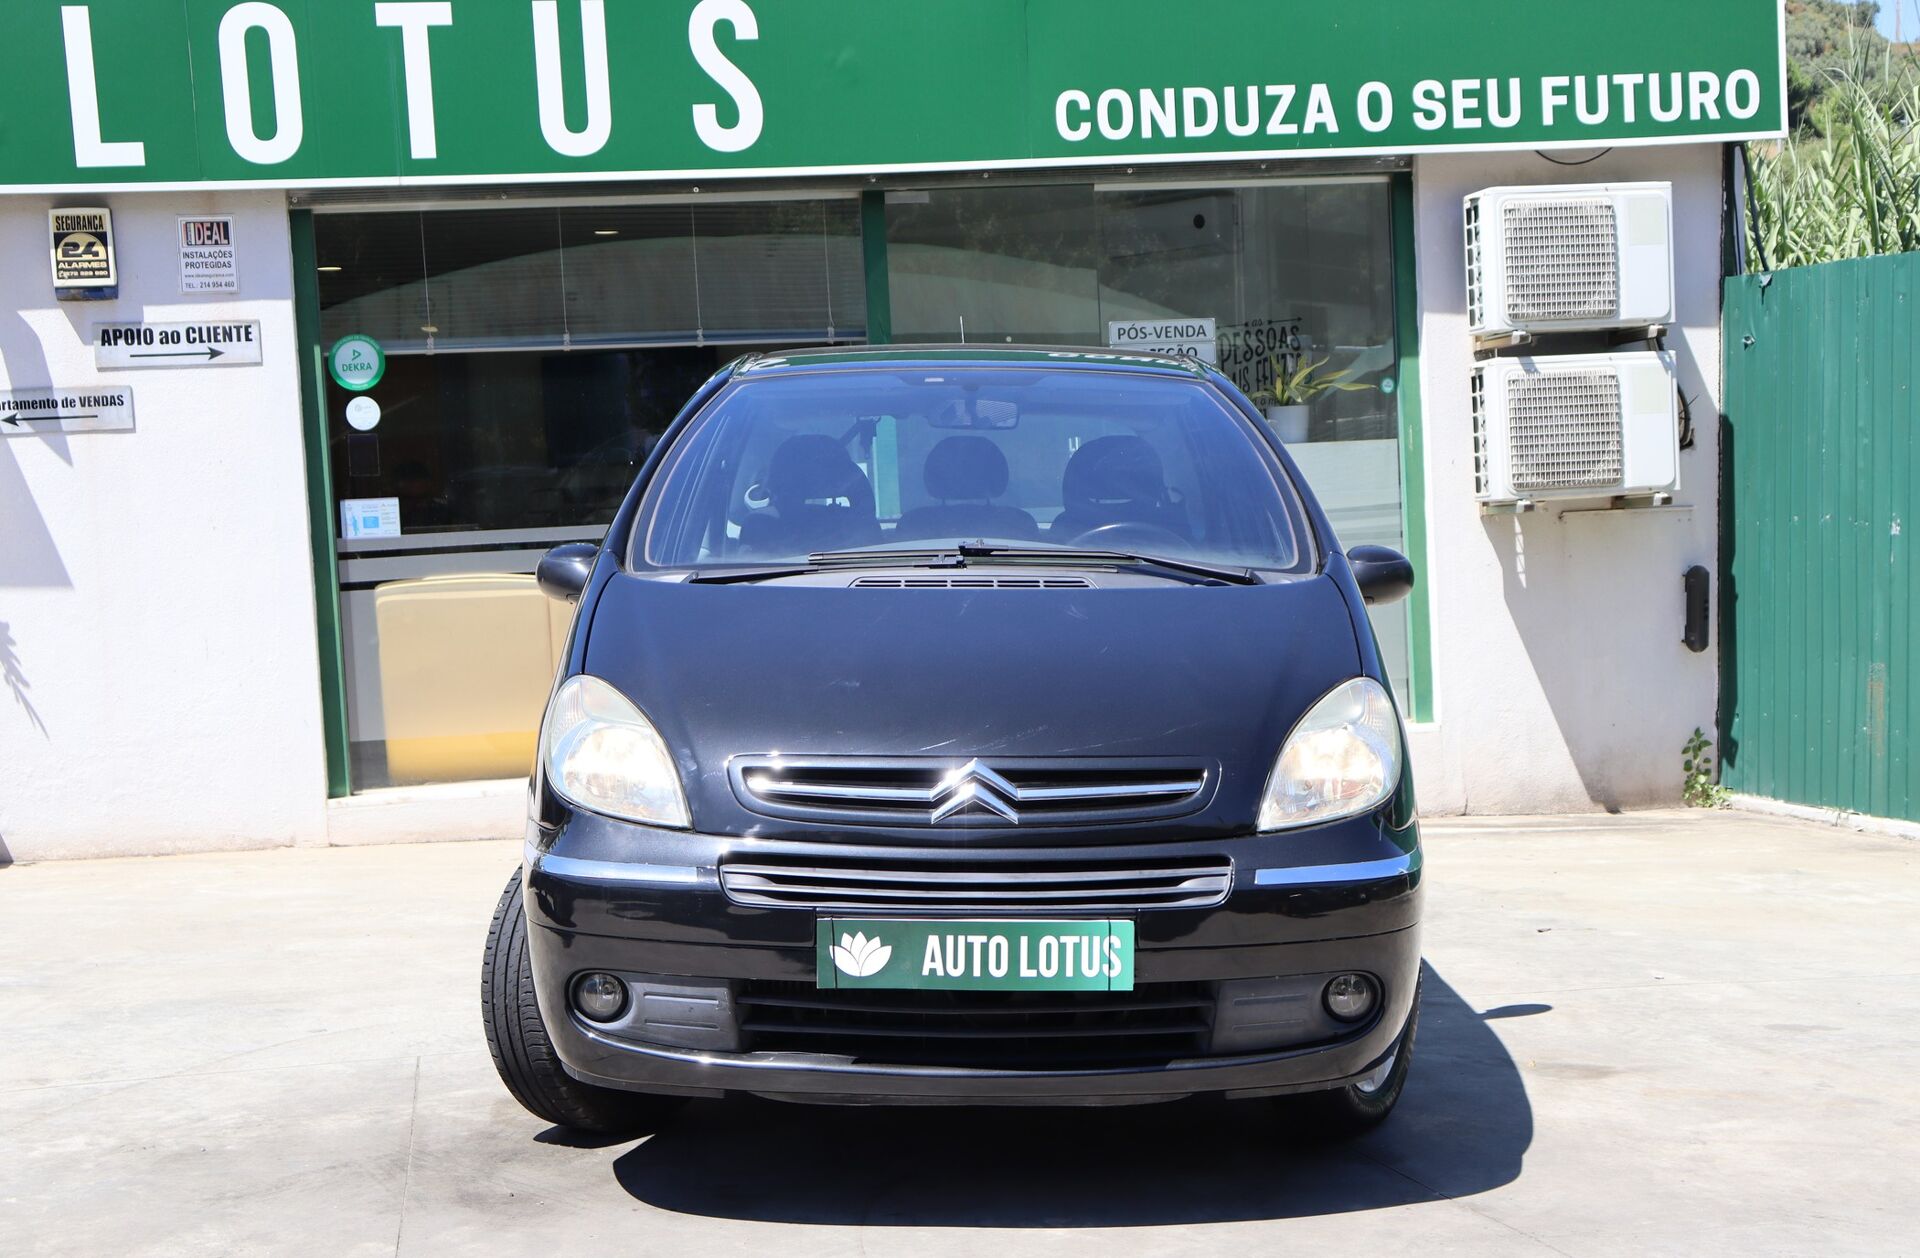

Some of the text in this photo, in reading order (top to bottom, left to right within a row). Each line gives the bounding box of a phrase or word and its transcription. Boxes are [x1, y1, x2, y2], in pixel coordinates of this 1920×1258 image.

[60, 0, 764, 168] LOTUS
[1054, 69, 1762, 142] CONDUZA O SEU FUTURO
[61, 241, 100, 258] 24
[182, 250, 233, 260] INSTALAÇÕES
[58, 261, 107, 269] ALARMES
[184, 261, 232, 269] PROTEGIDAS
[100, 325, 253, 347] APOIO ao CLIENTE
[1117, 323, 1207, 340] PÓS-VENDA
[1217, 325, 1302, 372] PESSOAS
[341, 362, 373, 372] DEKRA
[61, 396, 76, 409] de
[79, 394, 125, 408] VENDAS
[921, 934, 1123, 978] AUTO LOTUS
